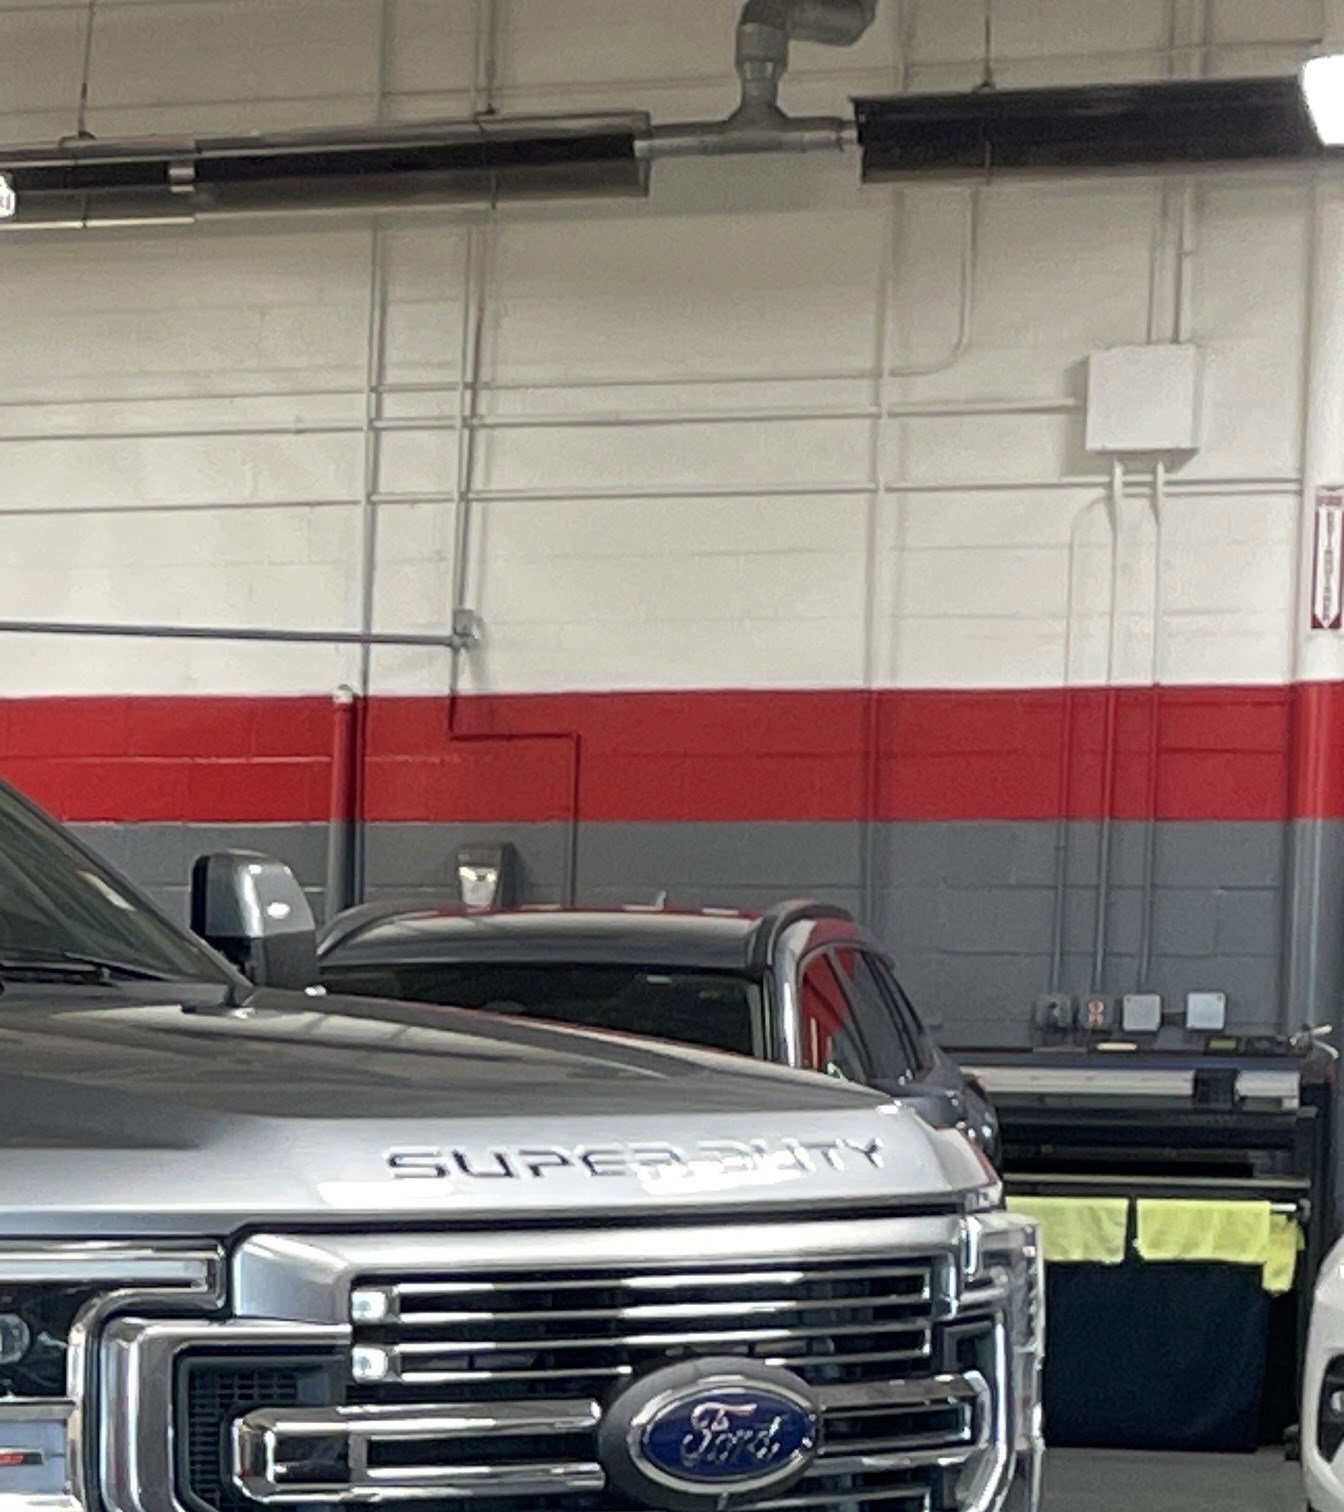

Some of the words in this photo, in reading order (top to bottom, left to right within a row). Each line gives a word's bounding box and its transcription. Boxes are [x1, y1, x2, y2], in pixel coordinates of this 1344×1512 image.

[386, 1142, 688, 1179] SUPER
[694, 1137, 885, 1173] DUTY
[680, 1402, 786, 1467] Ford
